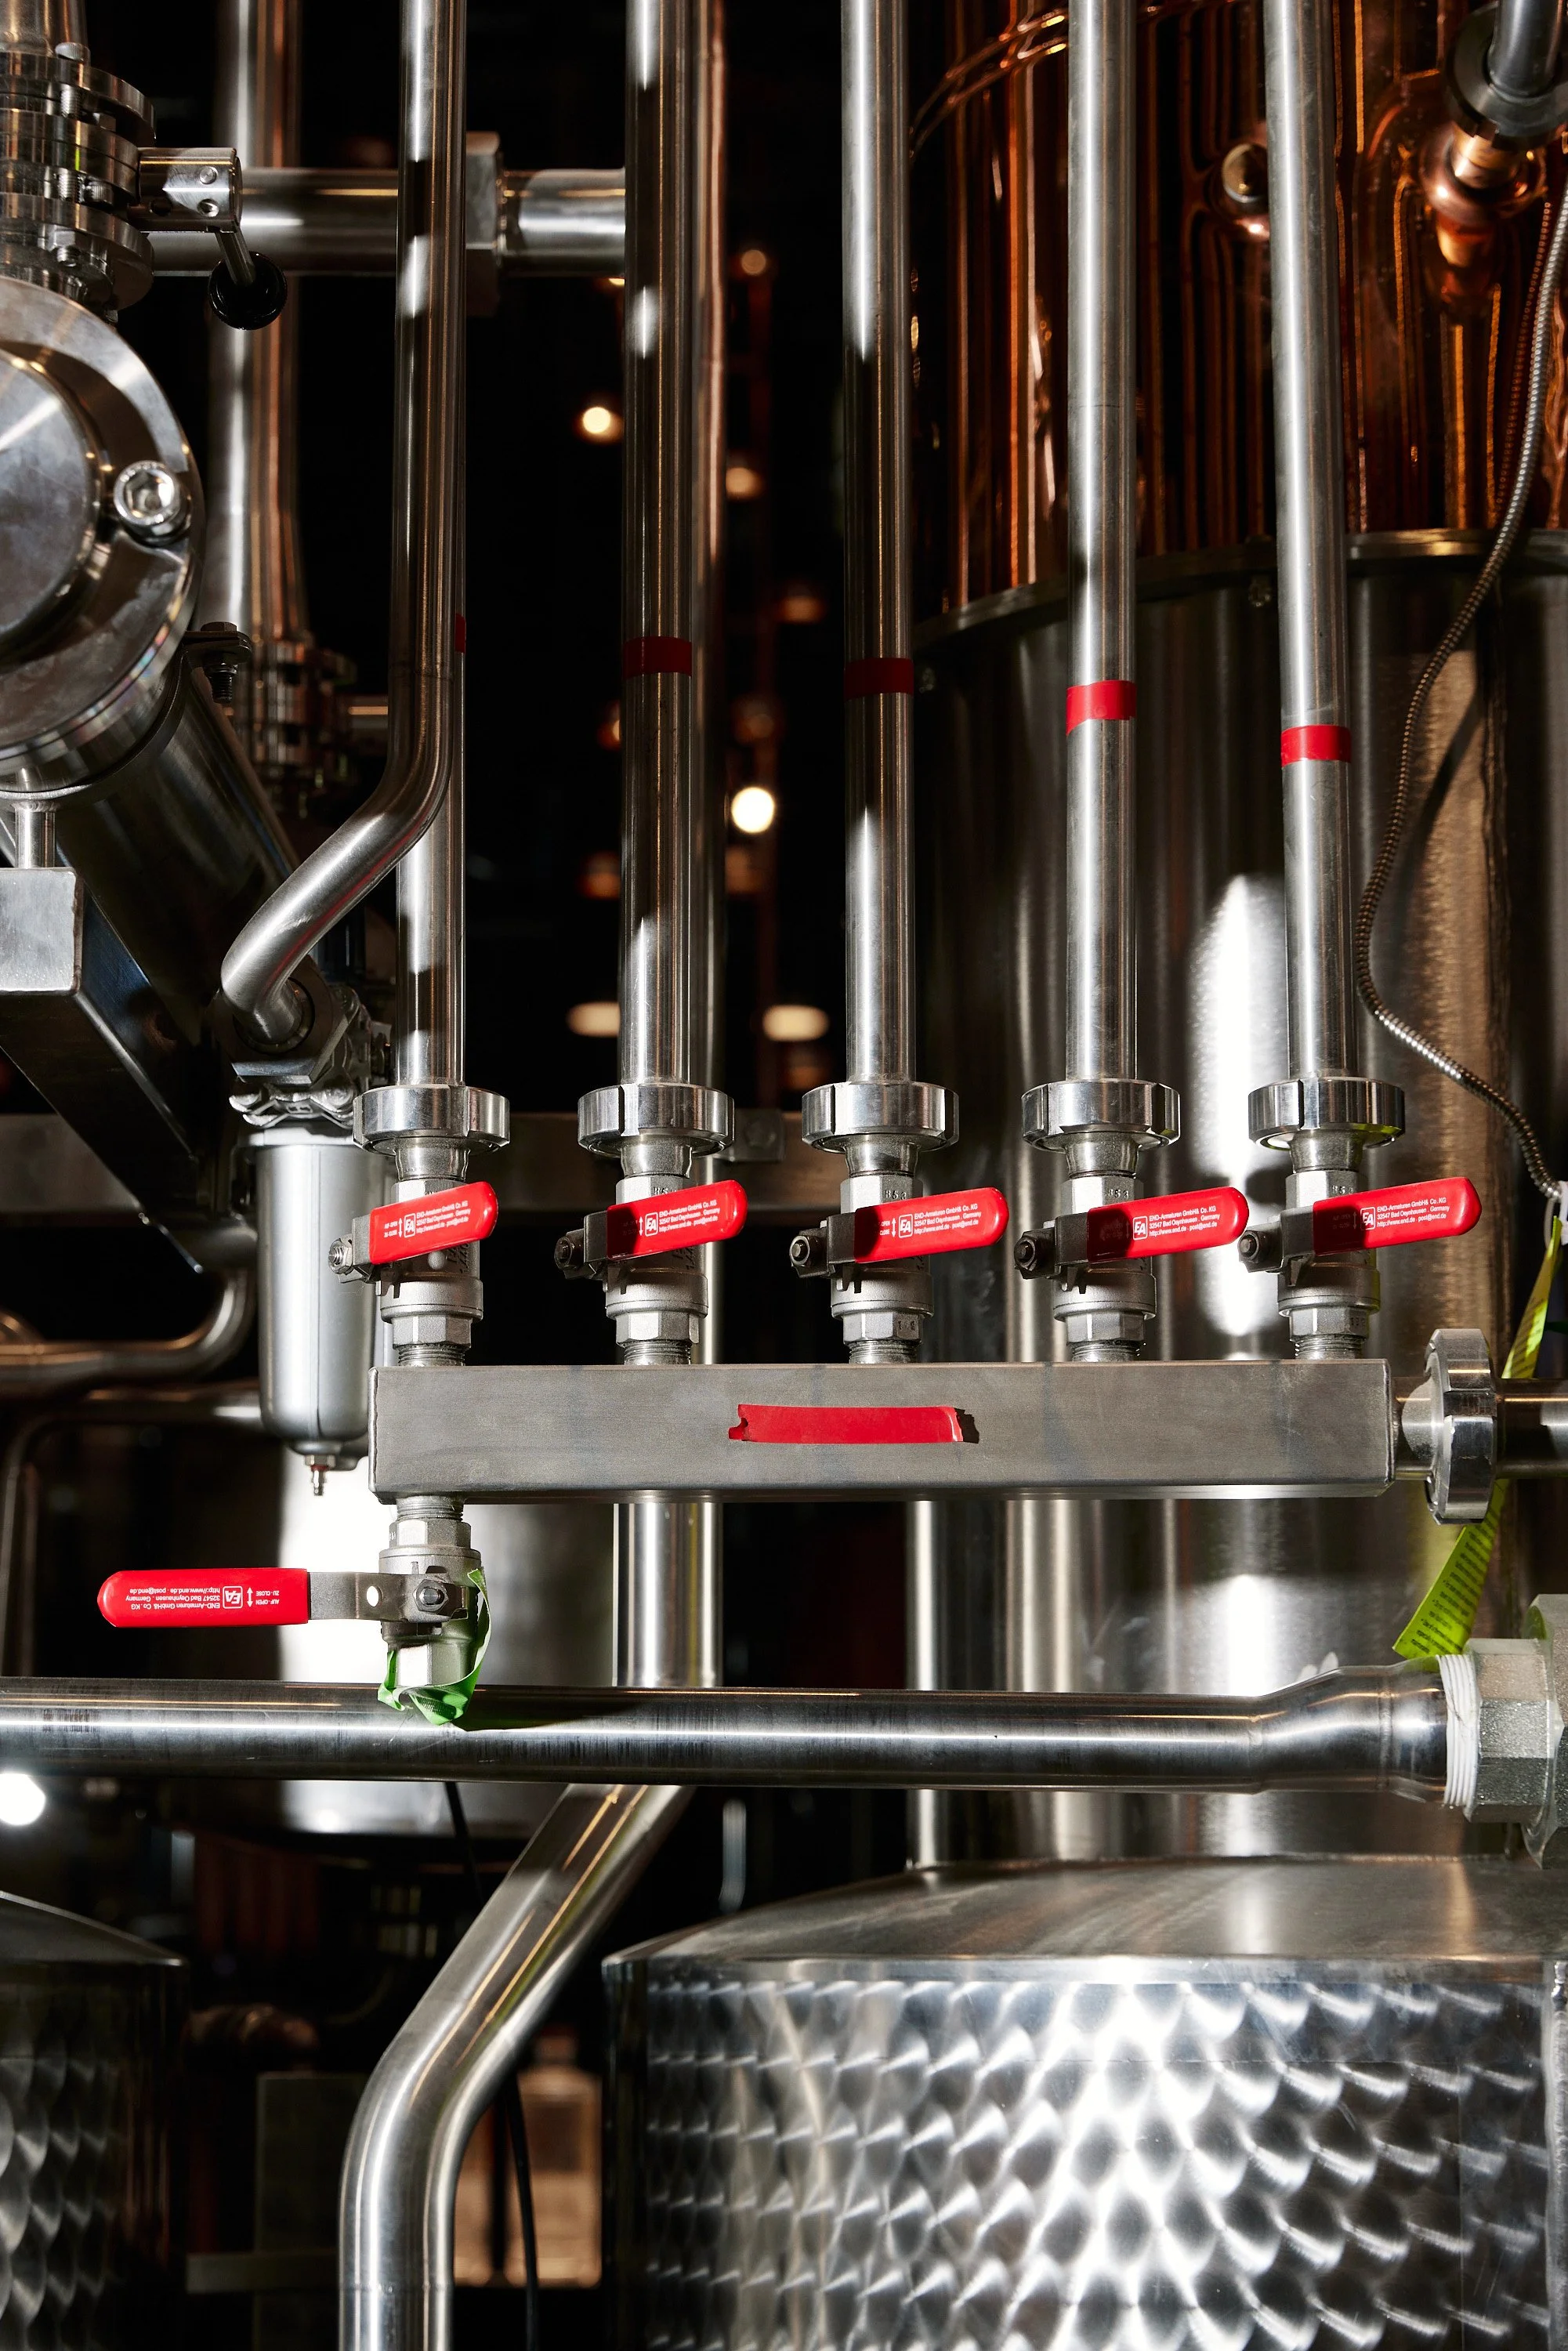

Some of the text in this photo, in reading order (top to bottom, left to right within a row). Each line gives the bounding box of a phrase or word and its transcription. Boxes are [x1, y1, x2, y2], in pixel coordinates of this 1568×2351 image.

[1430, 1206, 1450, 1215] Germany
[1200, 1214, 1220, 1223] Germany
[1363, 1212, 1374, 1226] EA
[225, 1591, 241, 1604] EA
